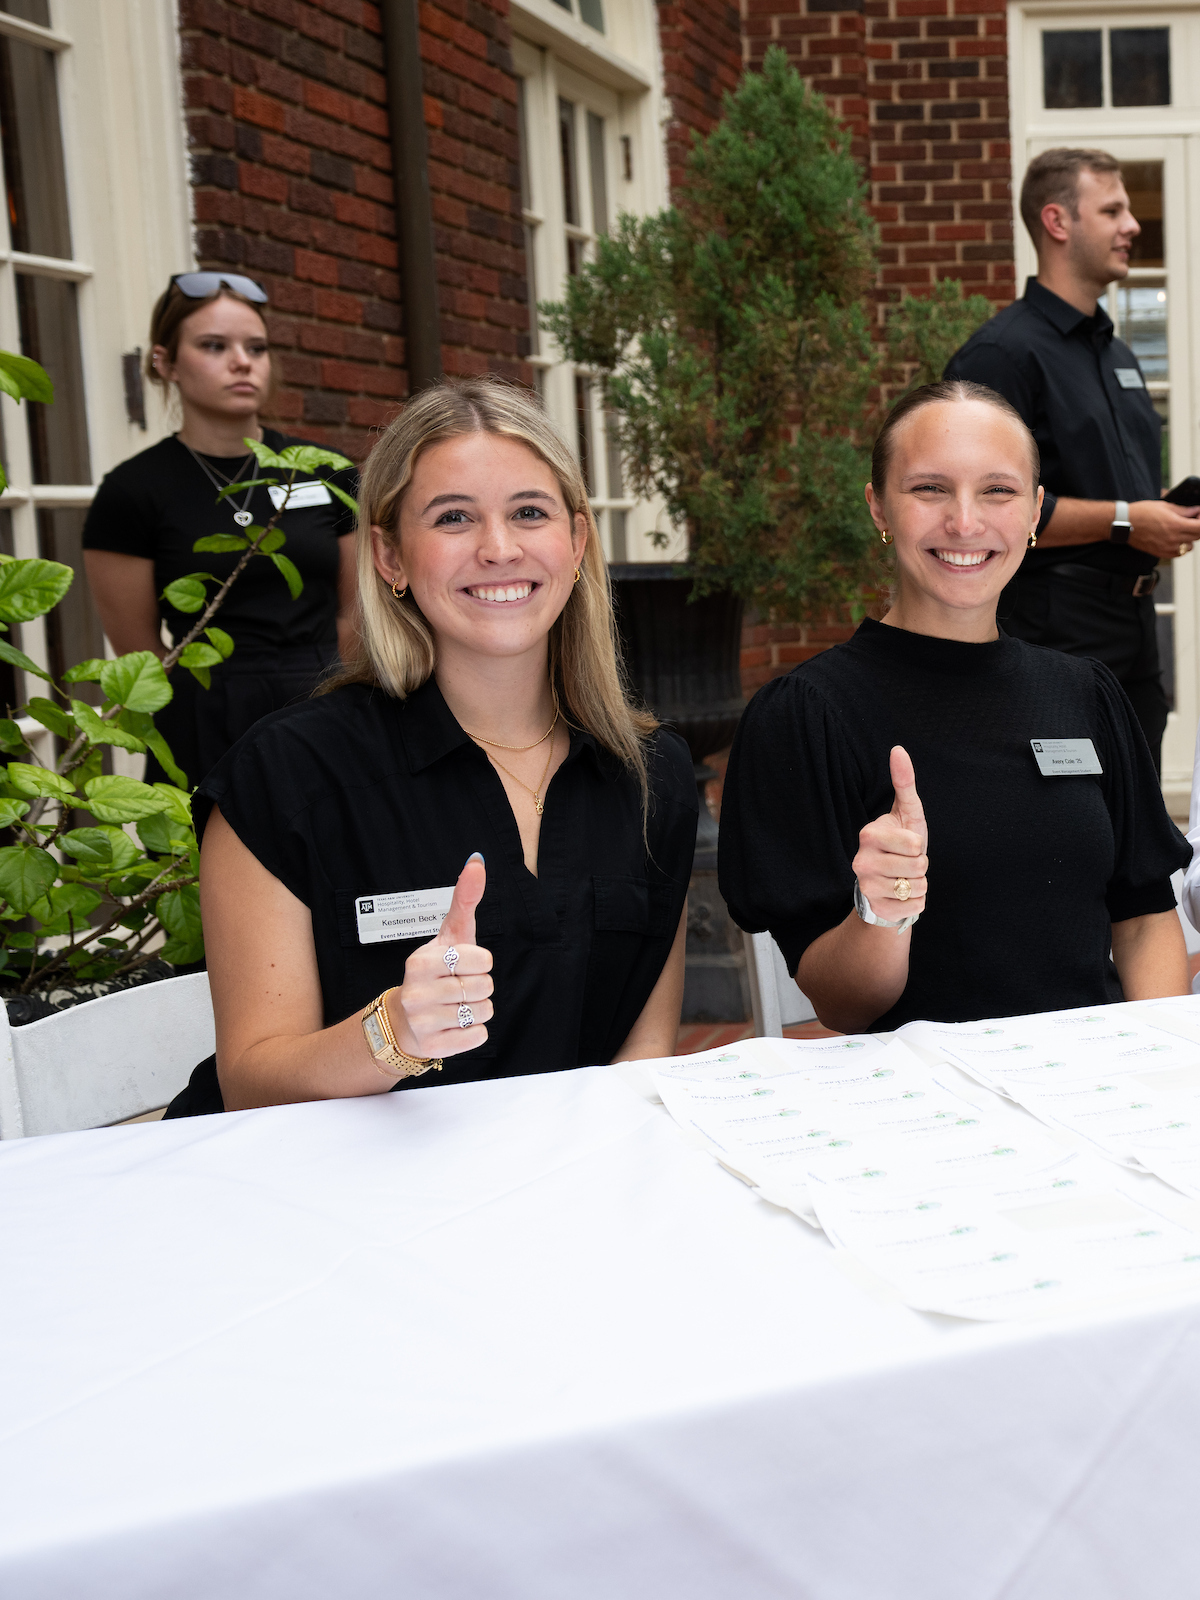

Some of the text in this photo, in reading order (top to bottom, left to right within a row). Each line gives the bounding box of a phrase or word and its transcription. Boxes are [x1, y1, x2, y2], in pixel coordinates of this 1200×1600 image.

[377, 899, 406, 907] Hospitality,
[377, 904, 411, 912] Management
[381, 916, 416, 927] Kesteren
[418, 913, 438, 923] Beck
[396, 928, 432, 937] Management
